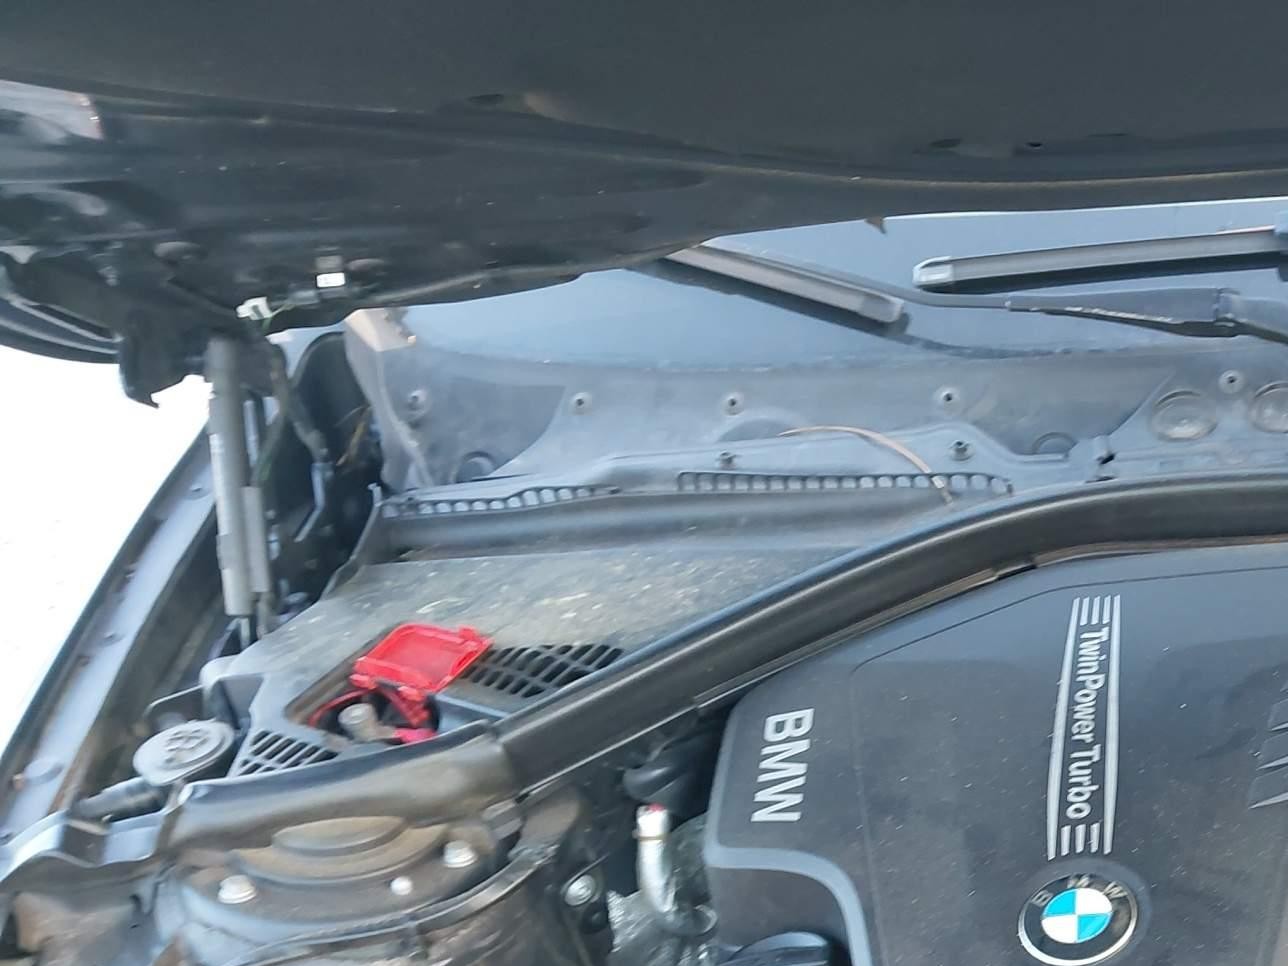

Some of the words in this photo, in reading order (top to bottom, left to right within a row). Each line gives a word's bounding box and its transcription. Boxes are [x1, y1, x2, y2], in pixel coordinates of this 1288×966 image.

[1071, 626, 1110, 744] TwinPower
[750, 708, 815, 822] BMW
[1065, 744, 1102, 820] Turbo
[1032, 873, 1129, 907] BMW
